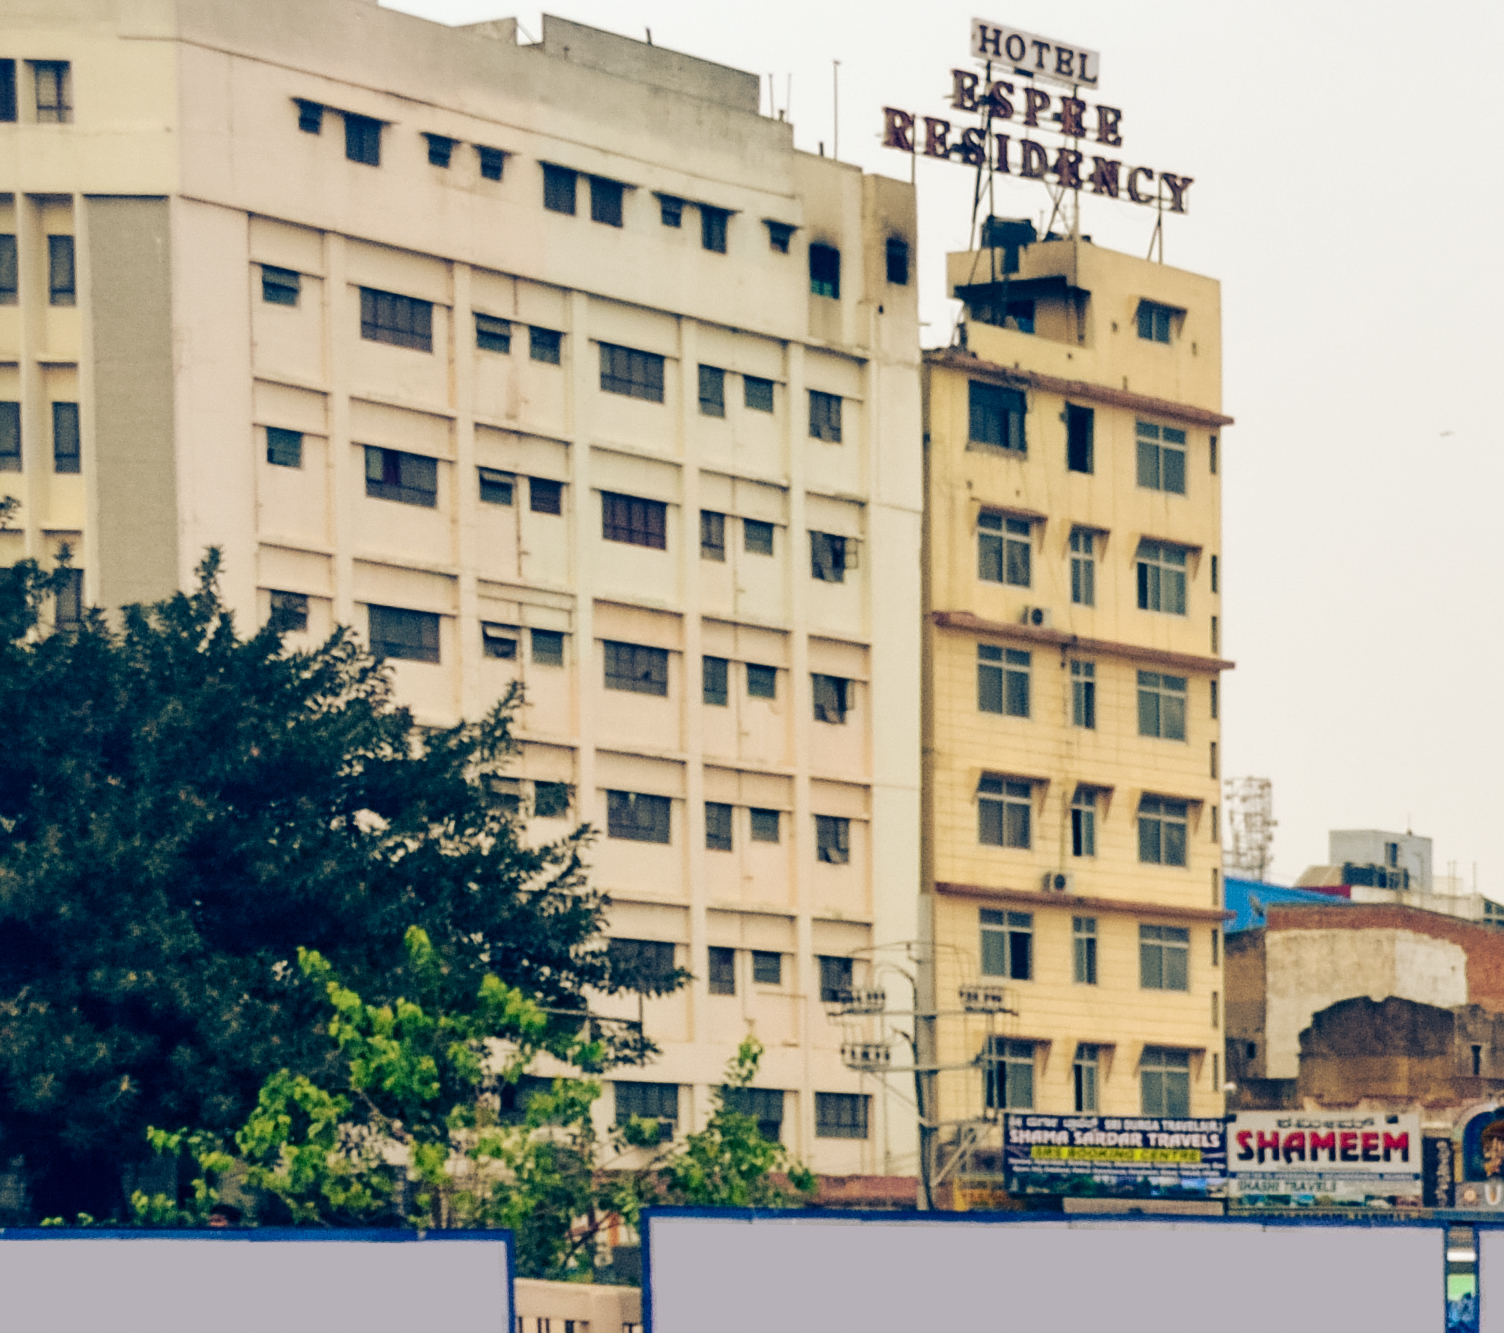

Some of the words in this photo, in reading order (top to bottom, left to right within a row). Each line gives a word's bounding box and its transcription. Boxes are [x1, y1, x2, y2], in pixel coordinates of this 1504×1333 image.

[978, 24, 1098, 84] HOTEL
[882, 106, 1194, 214] RESIDENCY
[1009, 1129, 1069, 1144] SHAMA
[1074, 1131, 1143, 1147] SARDAR
[1147, 1133, 1220, 1148] TRAVELS
[1236, 1130, 1409, 1164] SHAMEEM
